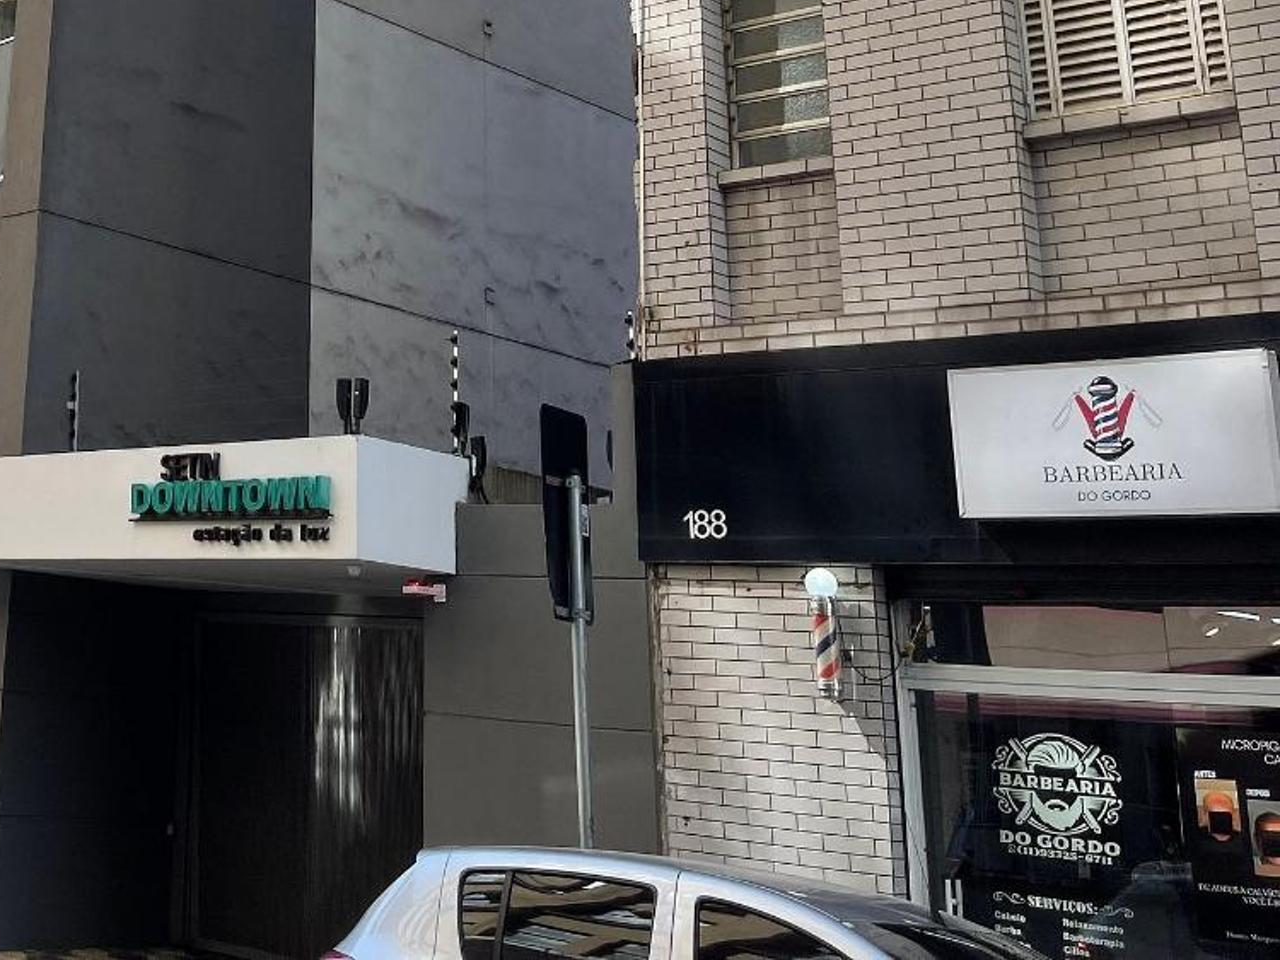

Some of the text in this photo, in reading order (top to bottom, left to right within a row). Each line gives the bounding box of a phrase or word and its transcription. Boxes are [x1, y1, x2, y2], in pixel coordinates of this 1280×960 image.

[160, 452, 220, 481] SETIN
[1042, 462, 1183, 482] BARBEARIA
[130, 474, 332, 514] DOWNTOWN
[1077, 489, 1151, 502] DO GORDO
[192, 524, 330, 547] estação da luz
[683, 509, 728, 539] 188
[1000, 772, 1117, 797] BARBEARIA
[999, 829, 1121, 857] DO GORDO
